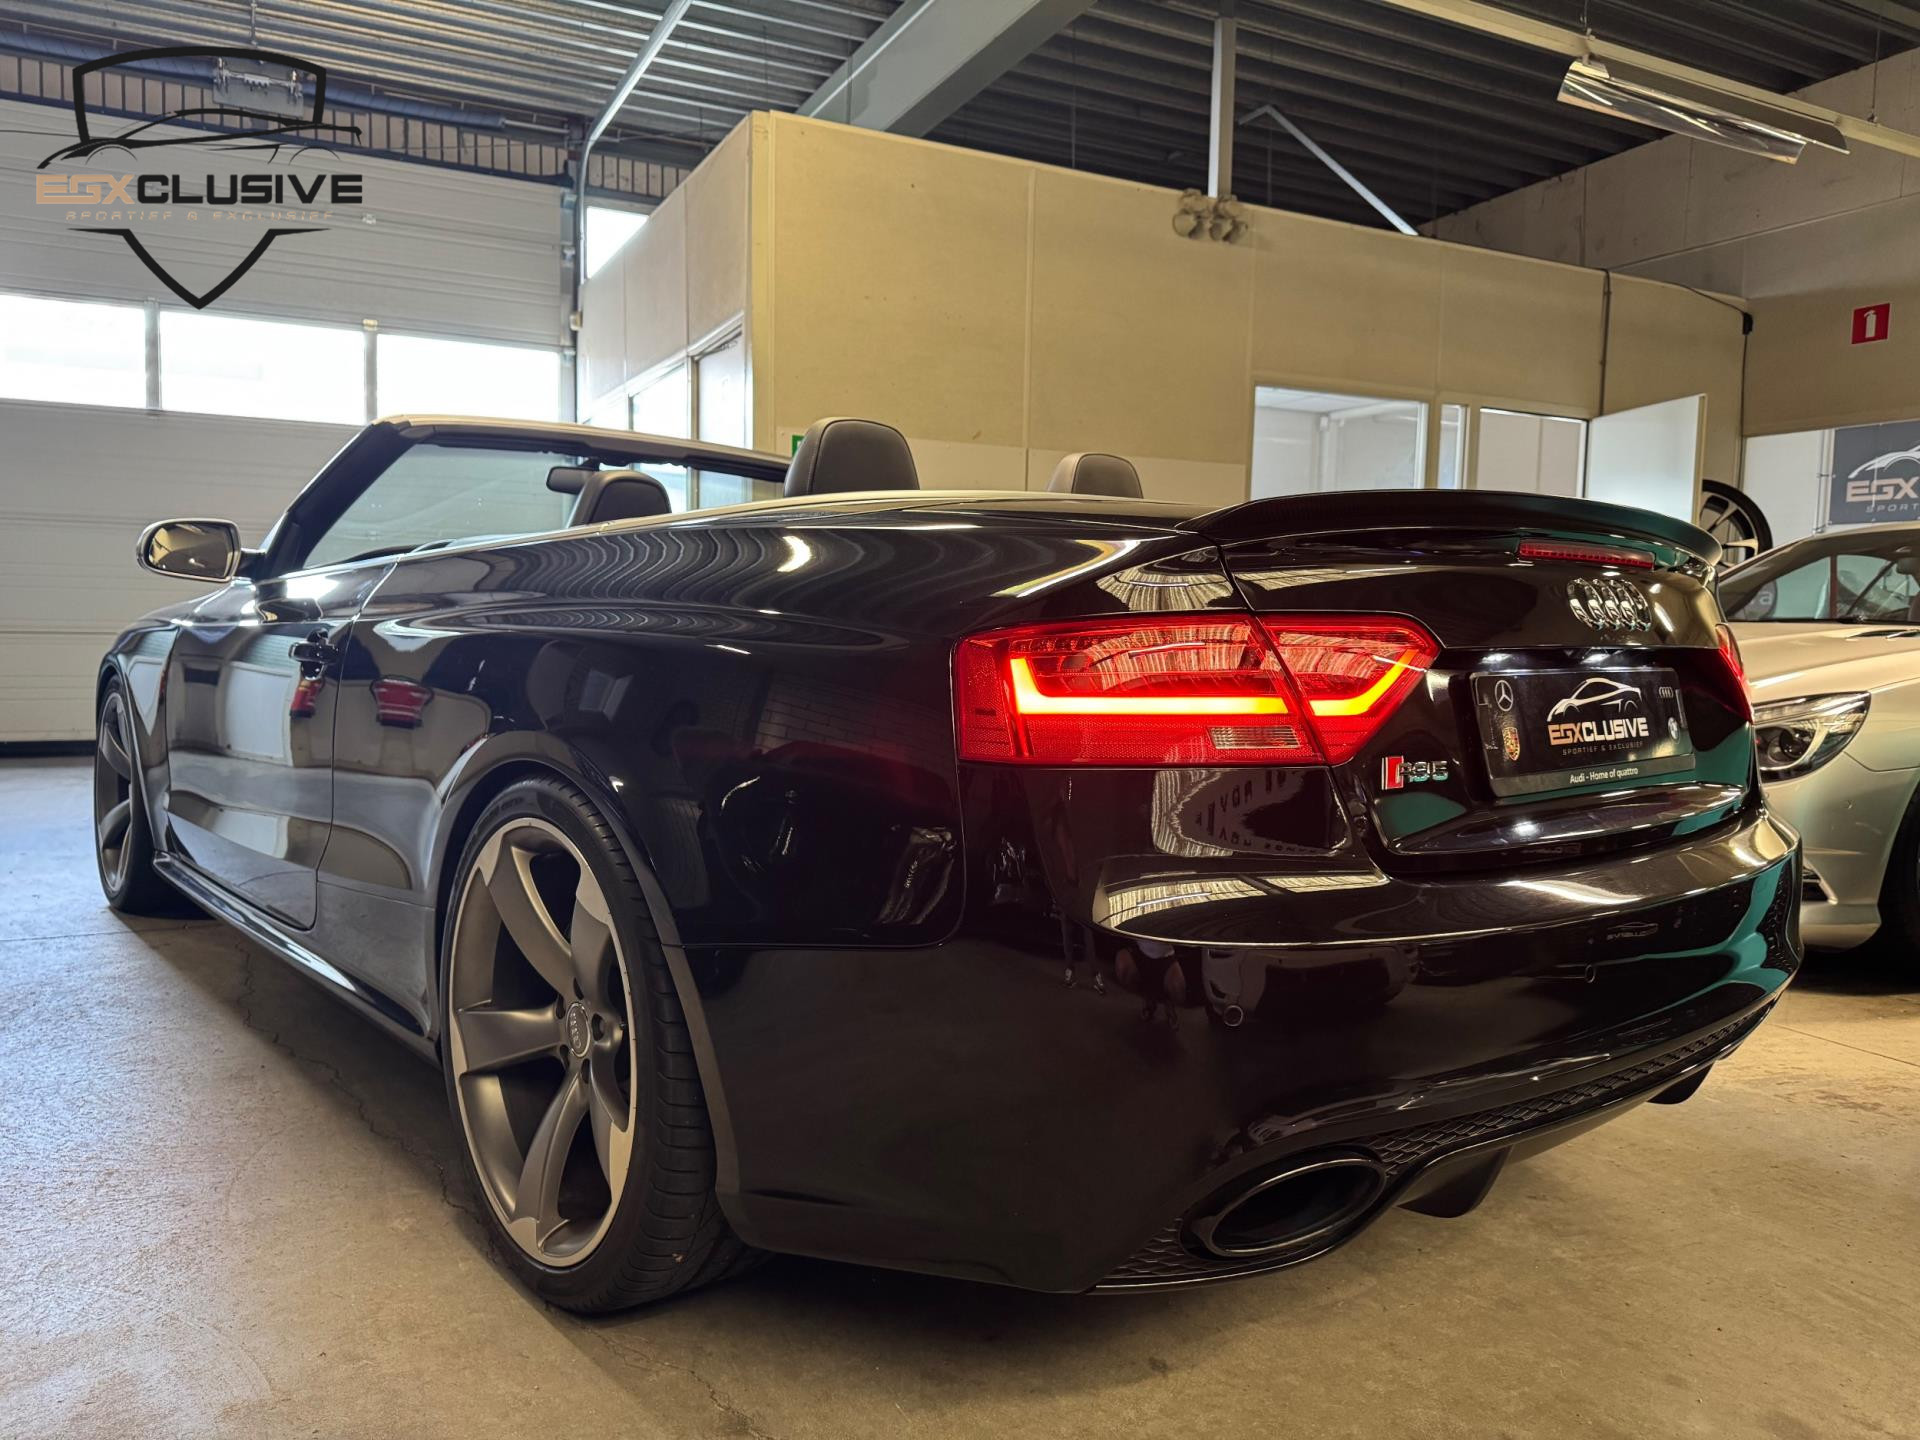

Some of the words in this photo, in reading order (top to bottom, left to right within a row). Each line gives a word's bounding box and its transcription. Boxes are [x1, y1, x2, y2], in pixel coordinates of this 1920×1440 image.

[1547, 717, 1650, 746] EGXCLUSIVE
[1569, 772, 1586, 784] Audi
[1589, 770, 1609, 781] Home
[1609, 768, 1616, 778] of
[1616, 767, 1639, 779] quattro
